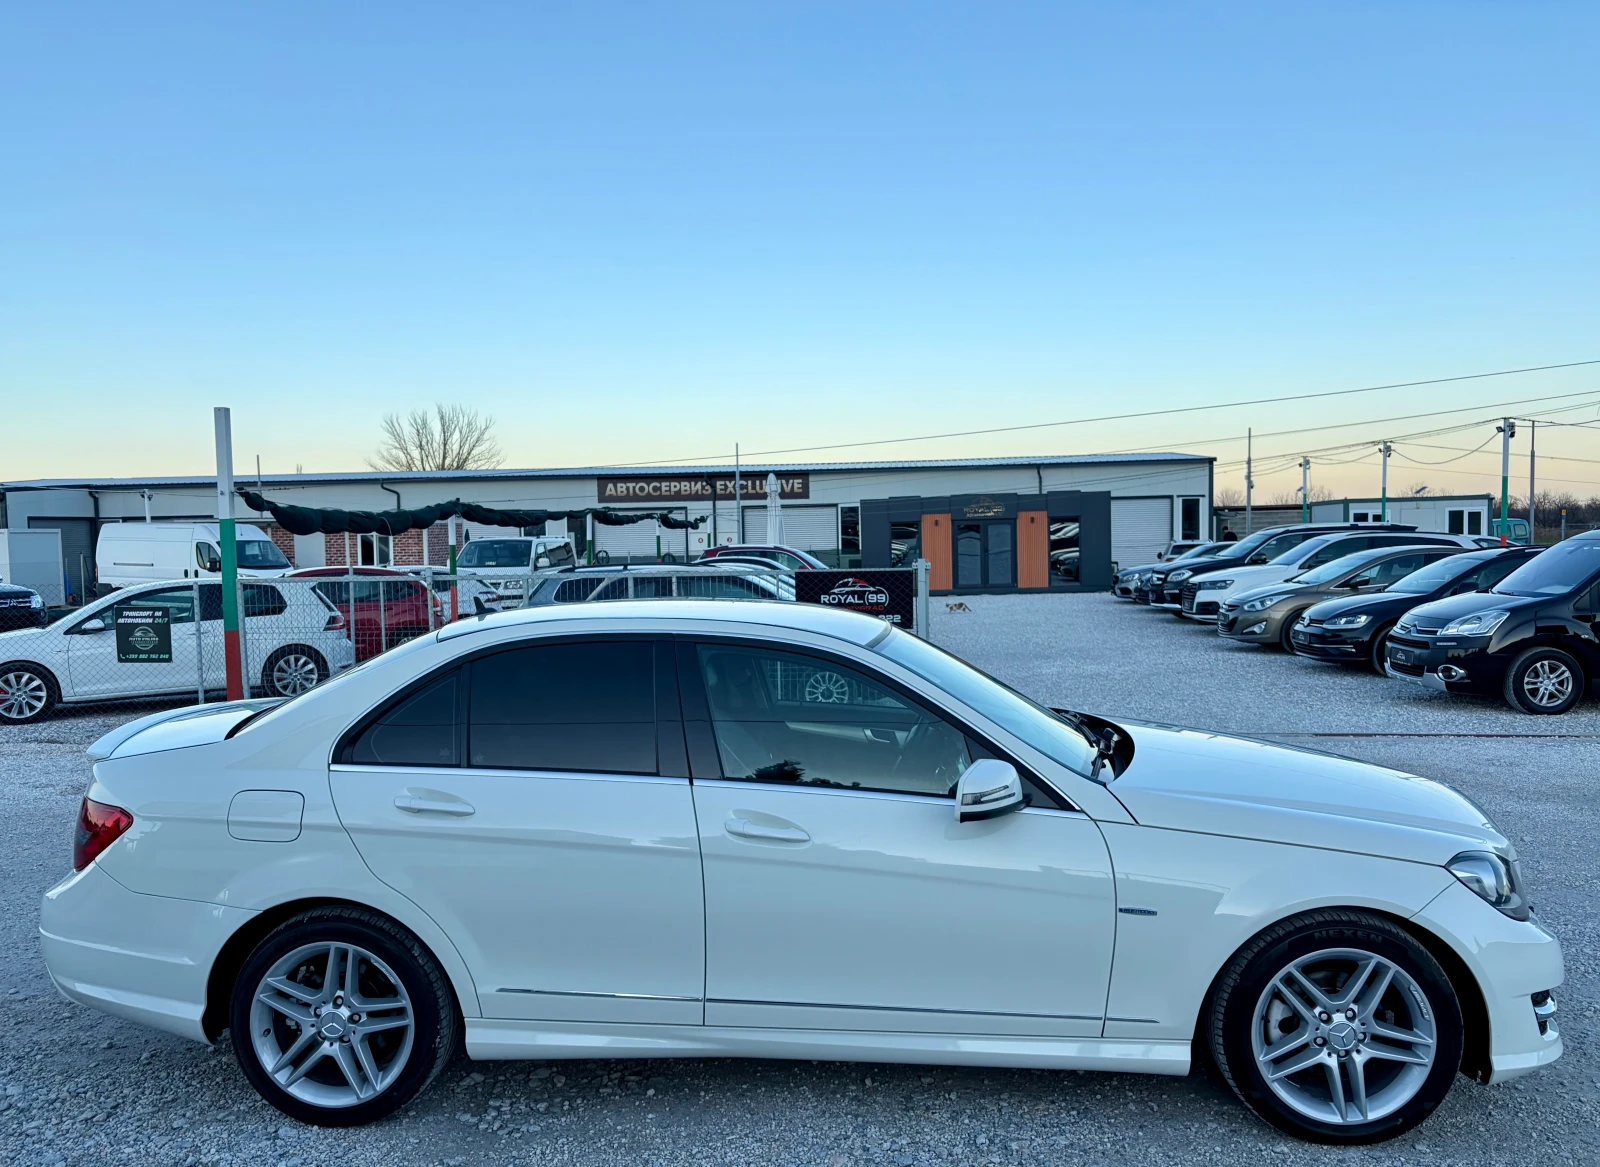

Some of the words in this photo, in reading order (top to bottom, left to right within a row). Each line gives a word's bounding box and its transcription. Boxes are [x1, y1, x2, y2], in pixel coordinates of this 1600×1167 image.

[605, 479, 711, 496] АВТОСЕРВИЗ
[716, 479, 803, 495] EXCLUIVE
[820, 594, 863, 604] ROYAL
[1313, 929, 1383, 943] NEXEN
